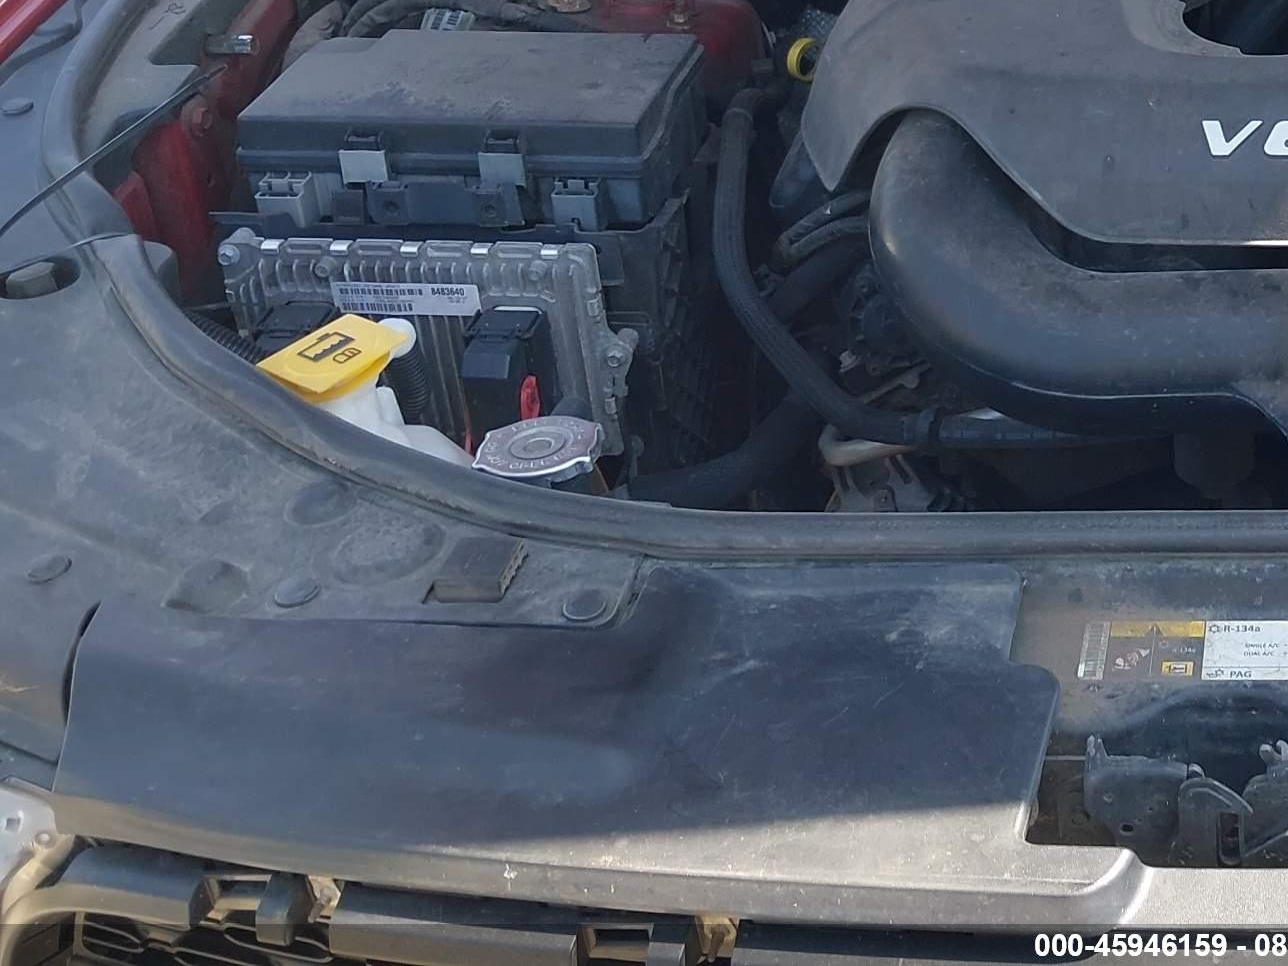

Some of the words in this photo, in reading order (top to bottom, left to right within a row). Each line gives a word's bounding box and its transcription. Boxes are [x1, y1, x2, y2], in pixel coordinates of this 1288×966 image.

[431, 287, 465, 296] 8483640
[1224, 624, 1261, 633] R-134a
[1230, 670, 1252, 678] PAG
